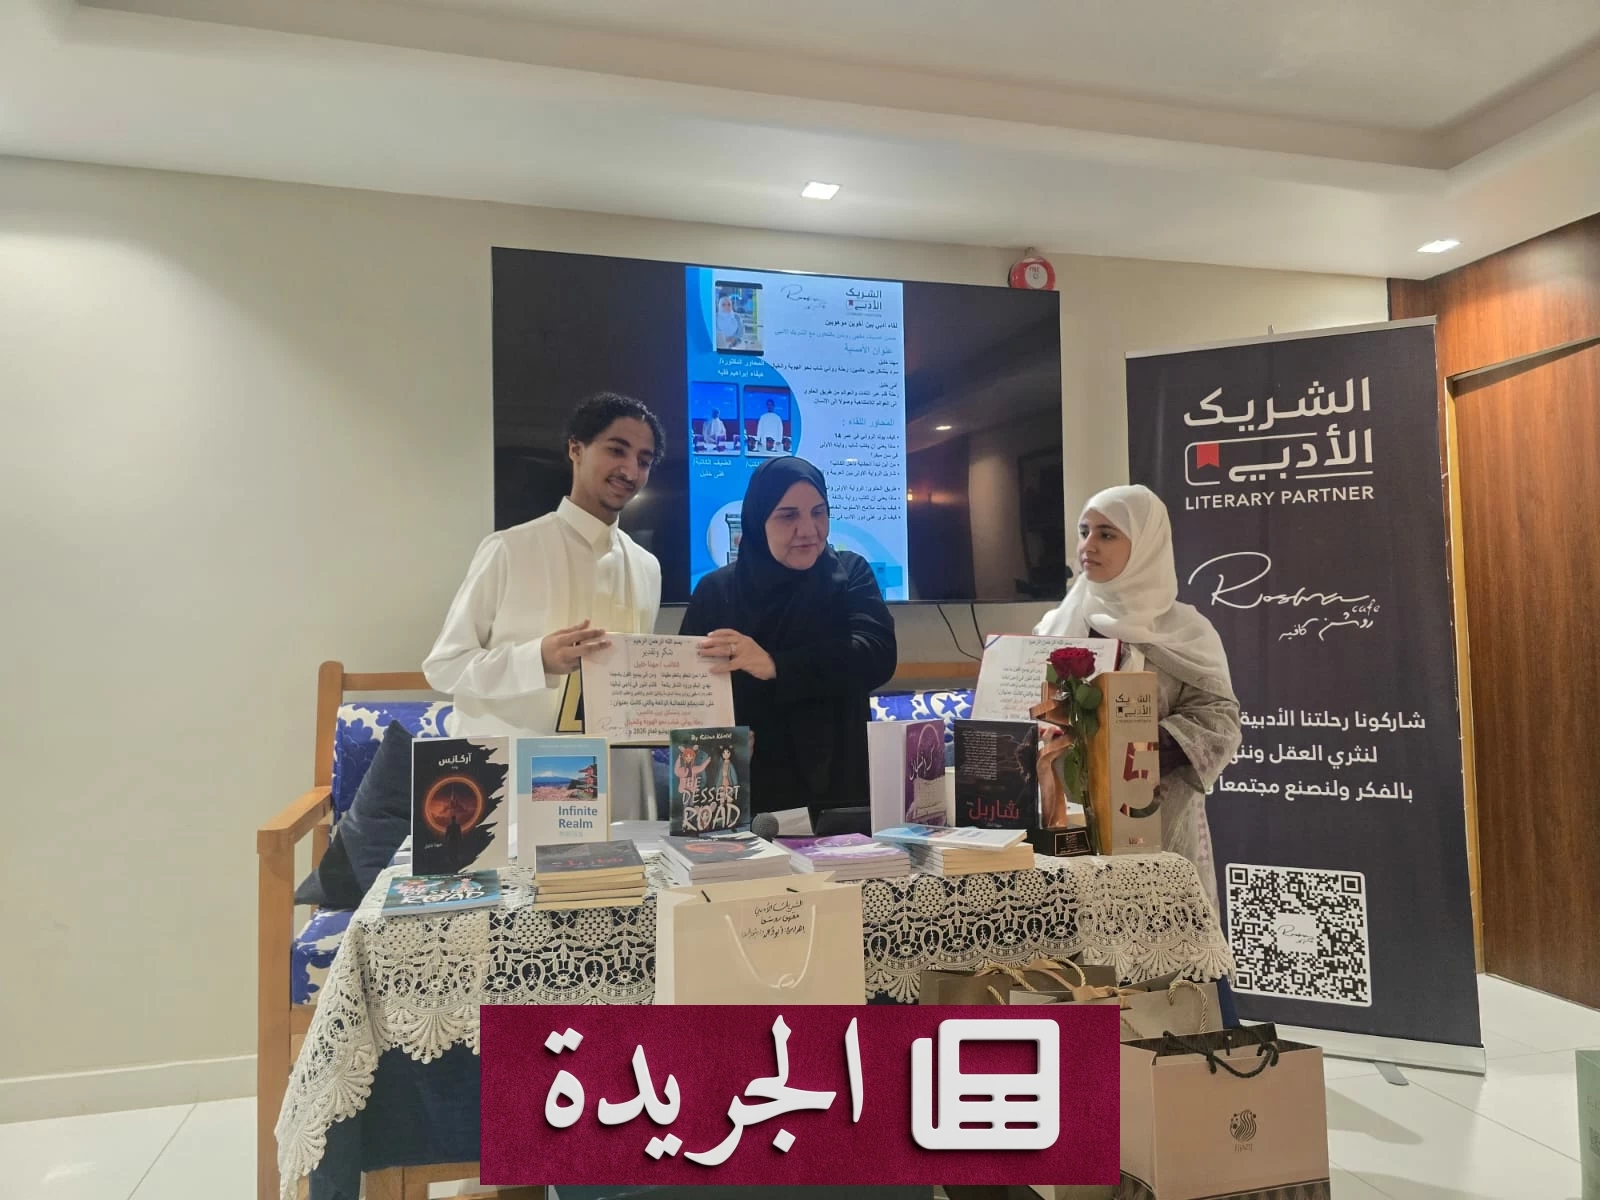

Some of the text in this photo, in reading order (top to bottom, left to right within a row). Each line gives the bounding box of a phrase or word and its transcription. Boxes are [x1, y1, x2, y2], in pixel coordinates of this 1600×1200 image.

[846, 288, 882, 299] الشريك
[855, 300, 882, 310] الأدبي
[1184, 376, 1370, 432] الشريك
[1229, 423, 1374, 482] الأدبي
[1185, 486, 1375, 510] LITERARY PARTNER
[1351, 598, 1380, 616] cafe
[1318, 611, 1374, 642] روشن
[1240, 708, 1426, 732] شاركونا رحلتنا الأدبية
[1269, 744, 1323, 764] العقل
[1328, 745, 1378, 770] لنثري
[682, 785, 740, 805] DESSERT
[1220, 775, 1280, 797] مجتمعا
[1284, 780, 1350, 800] ولنصنع
[1356, 782, 1413, 803] بالفكر
[558, 805, 598, 816] Infinite
[682, 802, 741, 832] ROAD
[968, 797, 1020, 822] شاربل
[558, 818, 593, 828] Realm
